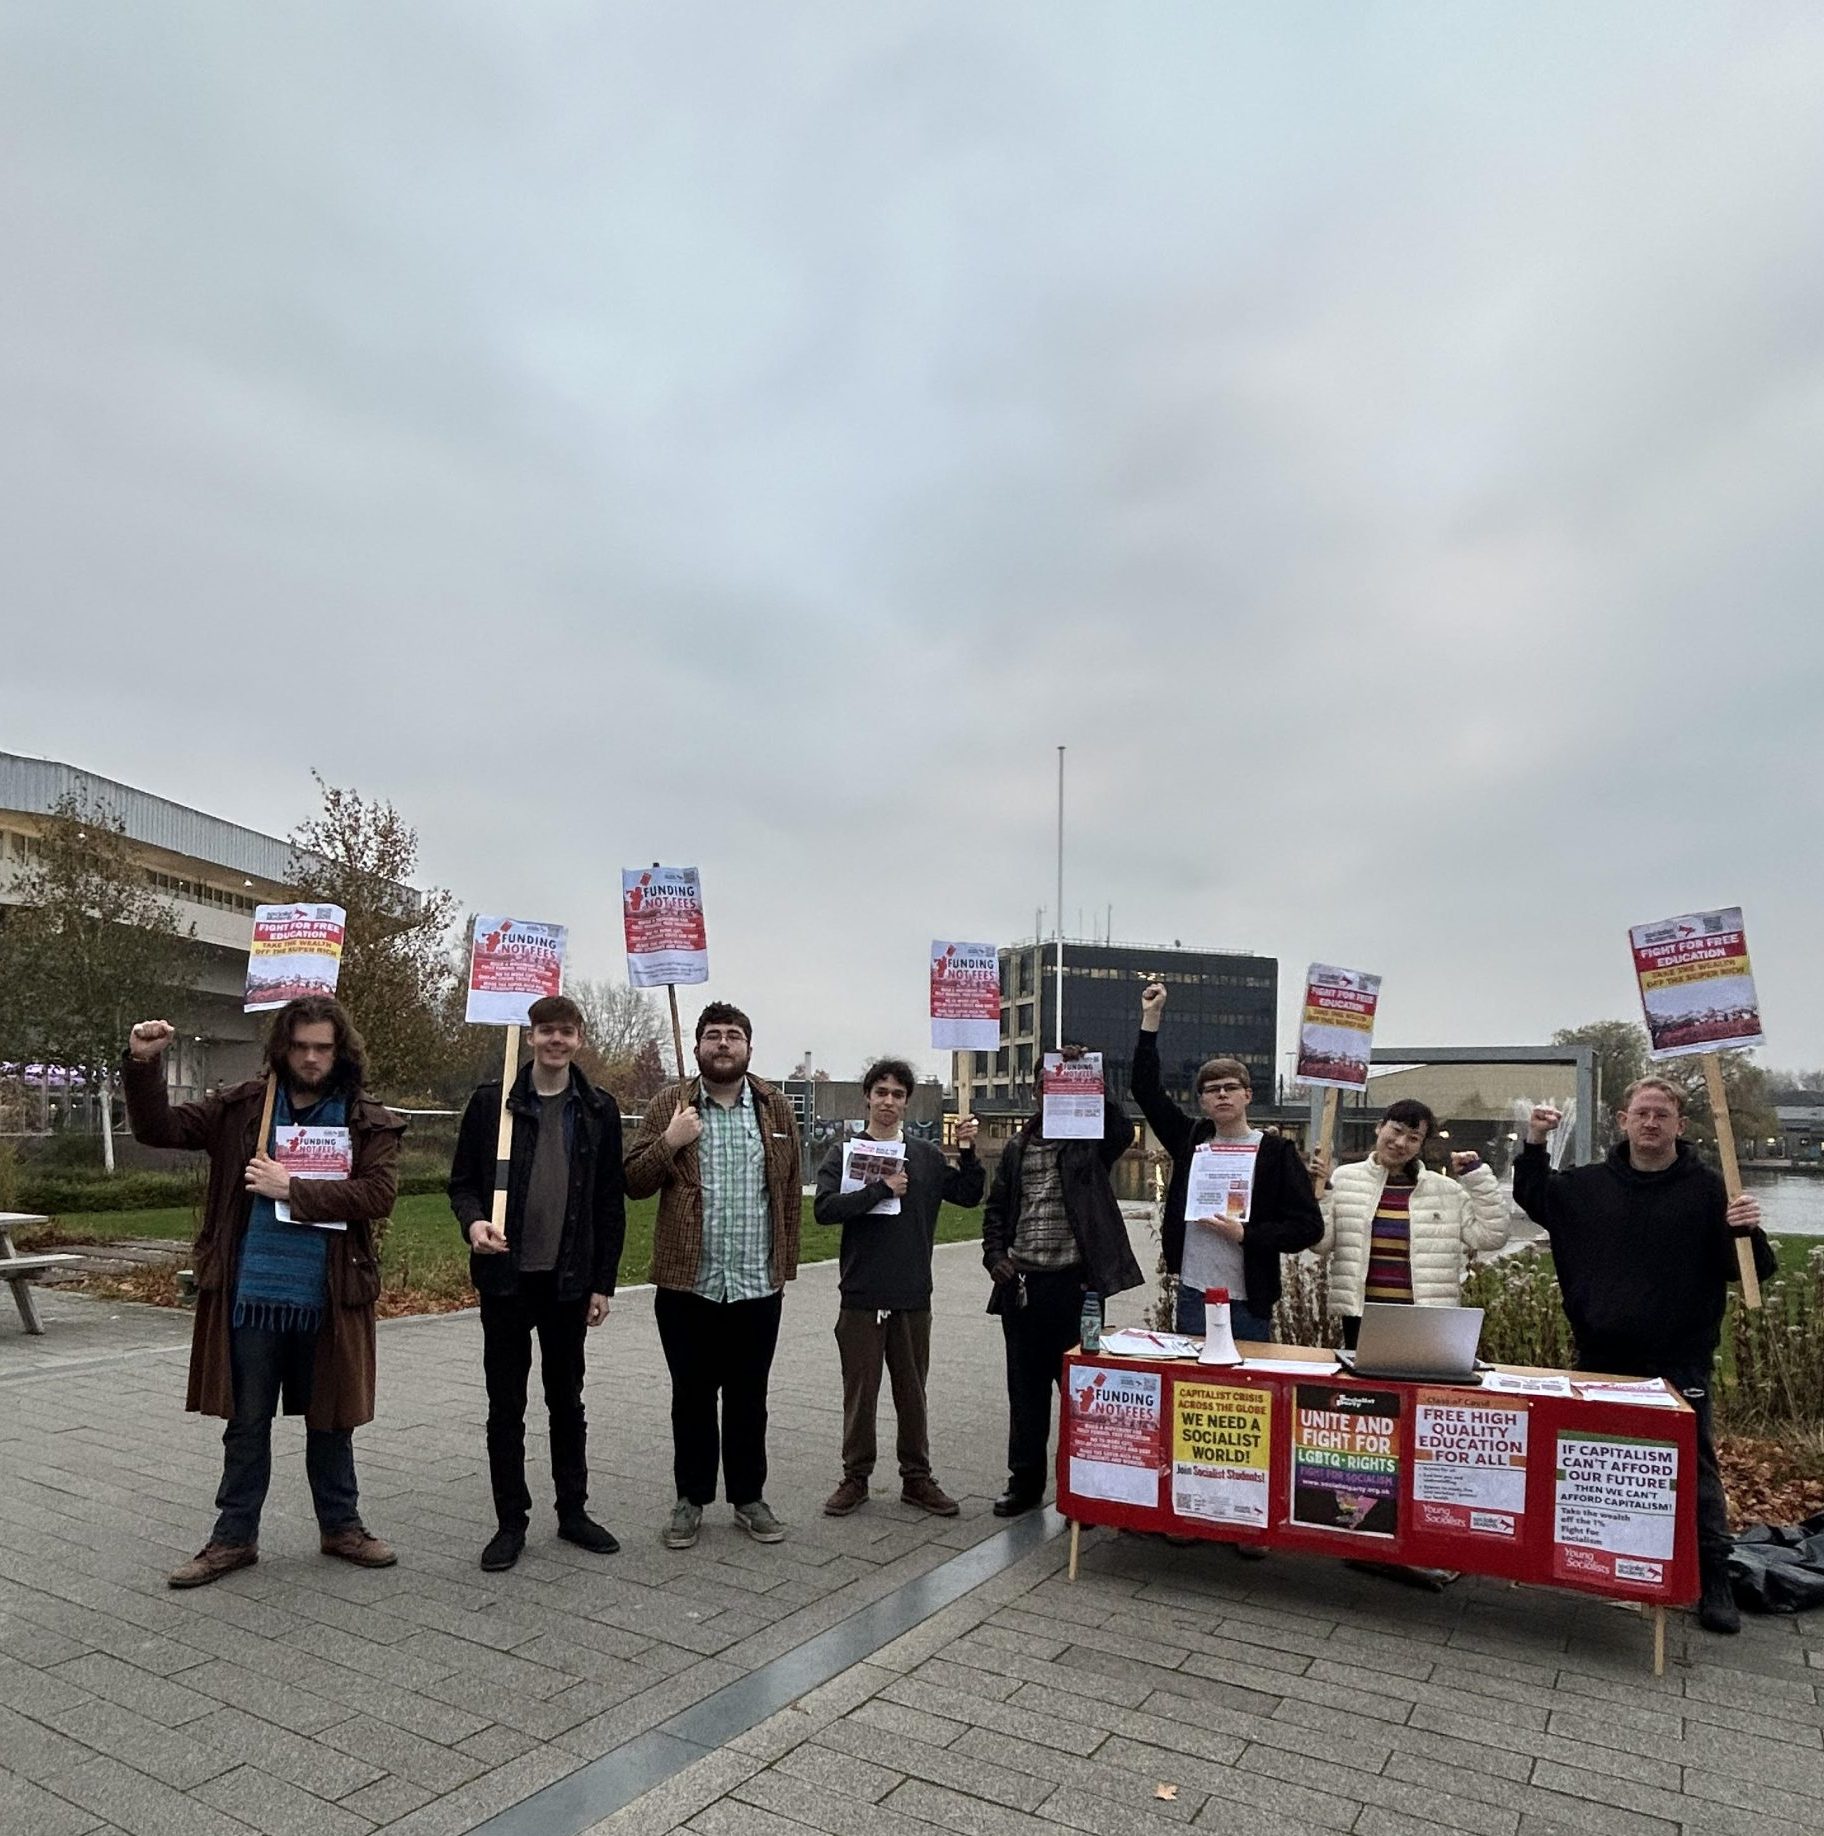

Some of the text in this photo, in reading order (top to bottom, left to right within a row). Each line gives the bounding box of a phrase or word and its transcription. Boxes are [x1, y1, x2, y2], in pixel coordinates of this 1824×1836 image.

[644, 885, 694, 898] FUNDING
[645, 897, 696, 909] NOT FEES
[258, 922, 340, 934] FIGHT FOR FREE
[269, 931, 327, 940] EDUCATION
[502, 933, 557, 950] FUNDING
[1641, 934, 1739, 959] FIGHT FOR FREE
[501, 943, 556, 960] NOT FEES
[1657, 948, 1726, 967] EDUCATION
[947, 958, 994, 970] FUNDING
[948, 970, 995, 981] NOT FEES
[299, 1138, 337, 1146] FUNDING
[299, 1145, 316, 1153] NOT
[1096, 1388, 1154, 1407] FUNDING
[1179, 1388, 1264, 1403] CAPITALIST CRISIS
[1096, 1402, 1154, 1420] NOT FEES
[1178, 1400, 1267, 1415] ACROSS THE GLOBE
[1181, 1412, 1261, 1431] WE NEED A
[1300, 1408, 1394, 1436] UNITE AND
[1423, 1408, 1517, 1426] FREE HIGH
[1182, 1429, 1261, 1448] SOCIALIST
[1432, 1422, 1509, 1439] QUALITY
[1302, 1428, 1391, 1455] FIGHT FOR
[1419, 1436, 1523, 1453] EDUCATION
[1192, 1446, 1250, 1464] WORLD!
[1435, 1450, 1507, 1466] FOR ALL
[1562, 1444, 1673, 1463] IF CAPITALISM
[1347, 1455, 1396, 1472] RIGHTS
[1562, 1457, 1673, 1476] CAN'T AFFORD
[1176, 1464, 1265, 1484] Join Socialist Students!
[1568, 1470, 1668, 1489] OUR FUTURE
[1575, 1484, 1658, 1500] THEN WE CAN'T
[1423, 1504, 1451, 1516] Young
[1560, 1494, 1673, 1511] AFFORD CAPITALISM!
[1424, 1513, 1466, 1527] Socialists
[1560, 1507, 1631, 1521] Take the wealth
[1561, 1516, 1575, 1524] off
[1576, 1517, 1592, 1525] the
[1560, 1525, 1600, 1536] Fight for
[1561, 1535, 1603, 1545] socialism
[1564, 1547, 1594, 1562] Young
[1566, 1557, 1610, 1575] Socialists
